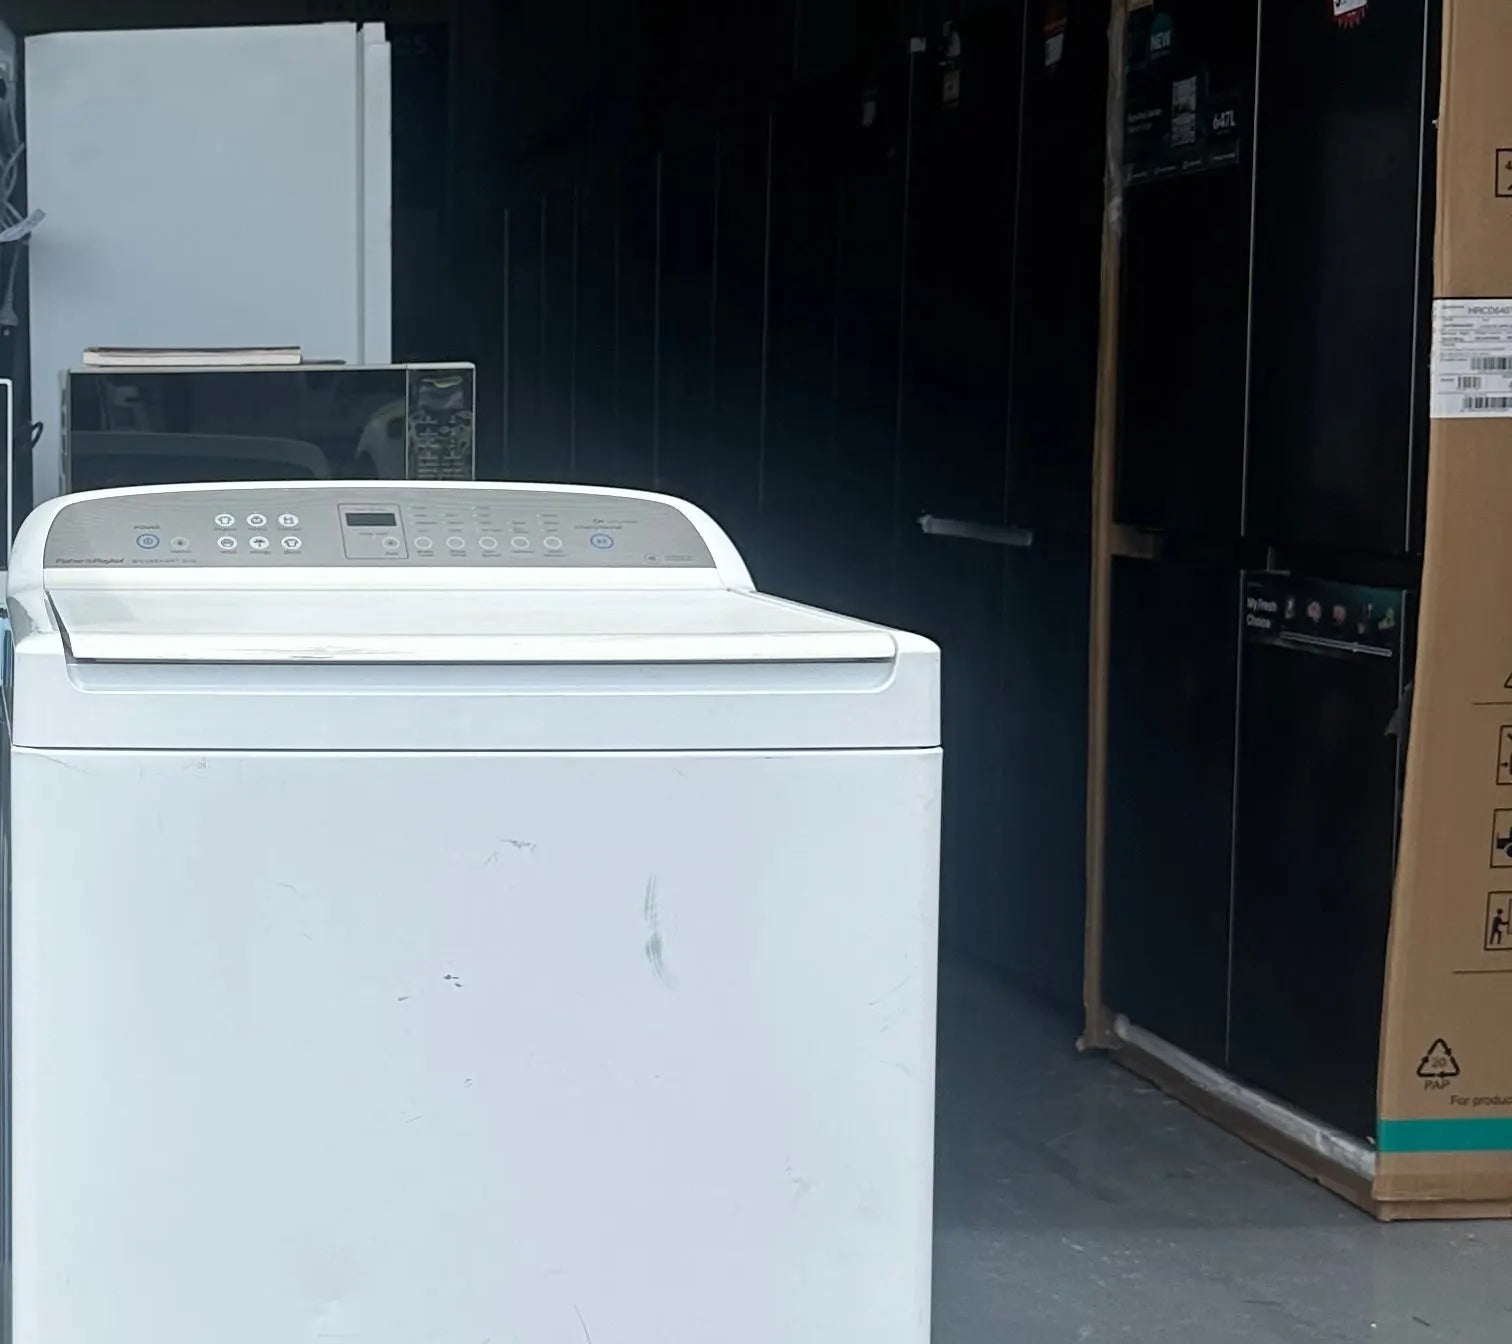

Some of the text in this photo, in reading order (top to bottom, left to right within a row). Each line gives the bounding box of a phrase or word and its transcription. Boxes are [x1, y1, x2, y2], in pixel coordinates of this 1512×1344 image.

[1149, 29, 1172, 53] NEW
[1424, 1079, 1451, 1091] PAP
[1450, 1095, 1471, 1106] For
